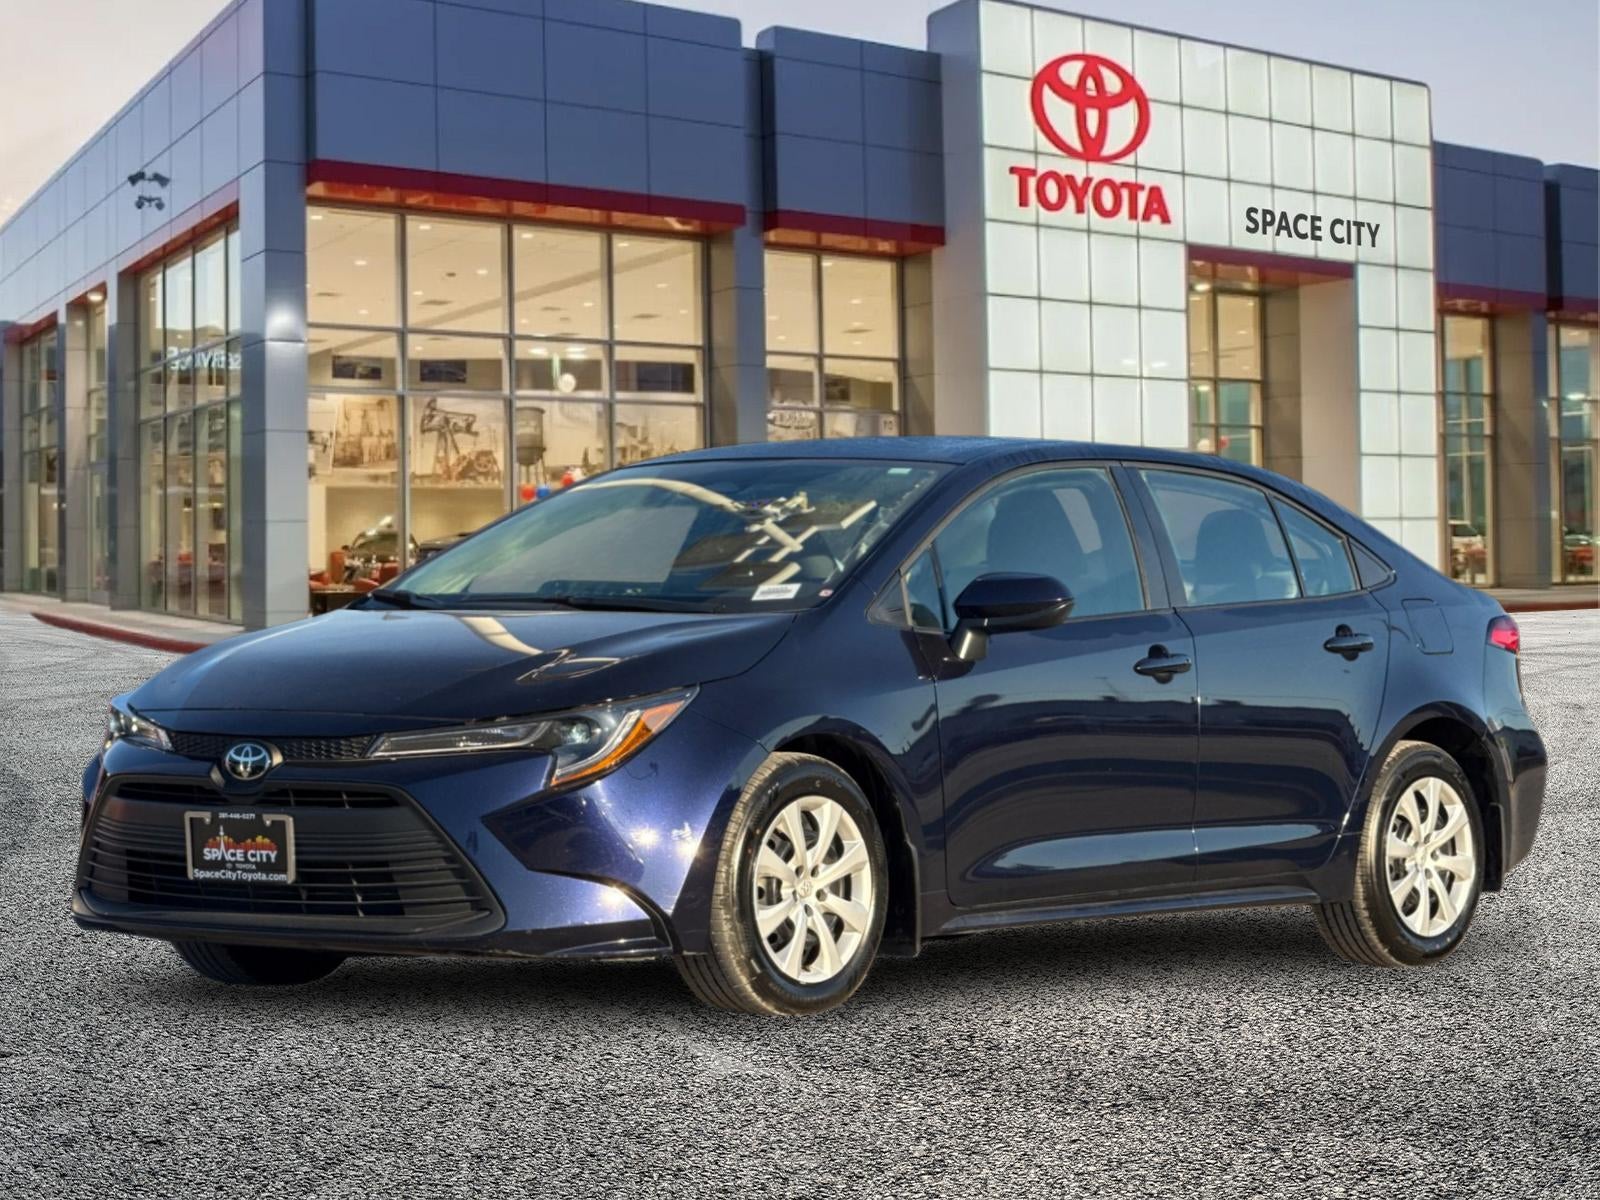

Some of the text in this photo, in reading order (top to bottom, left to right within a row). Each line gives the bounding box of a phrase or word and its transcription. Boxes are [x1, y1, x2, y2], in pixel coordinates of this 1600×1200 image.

[1009, 166, 1171, 224] TOYOTA
[1245, 207, 1381, 248] SPACE CITY
[203, 848, 277, 863] SPACE CITY
[193, 869, 287, 881] SpaceCityToyota.com
